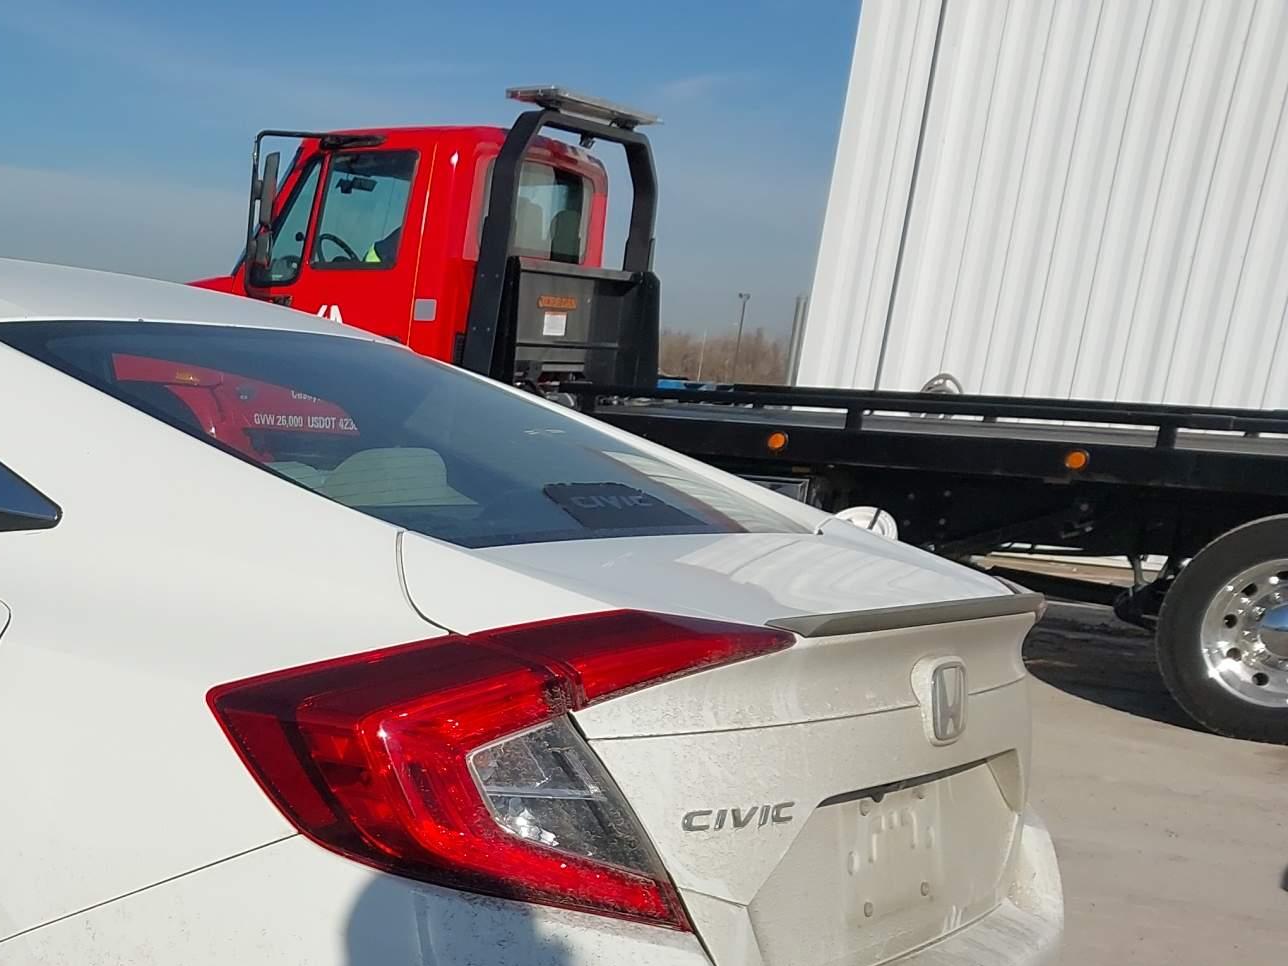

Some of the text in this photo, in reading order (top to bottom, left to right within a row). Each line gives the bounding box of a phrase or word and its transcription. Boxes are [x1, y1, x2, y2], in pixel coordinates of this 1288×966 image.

[254, 413, 275, 425] GVW
[277, 415, 303, 428] 26,000
[307, 415, 336, 429] USDOT
[682, 801, 794, 832] CIVIC
